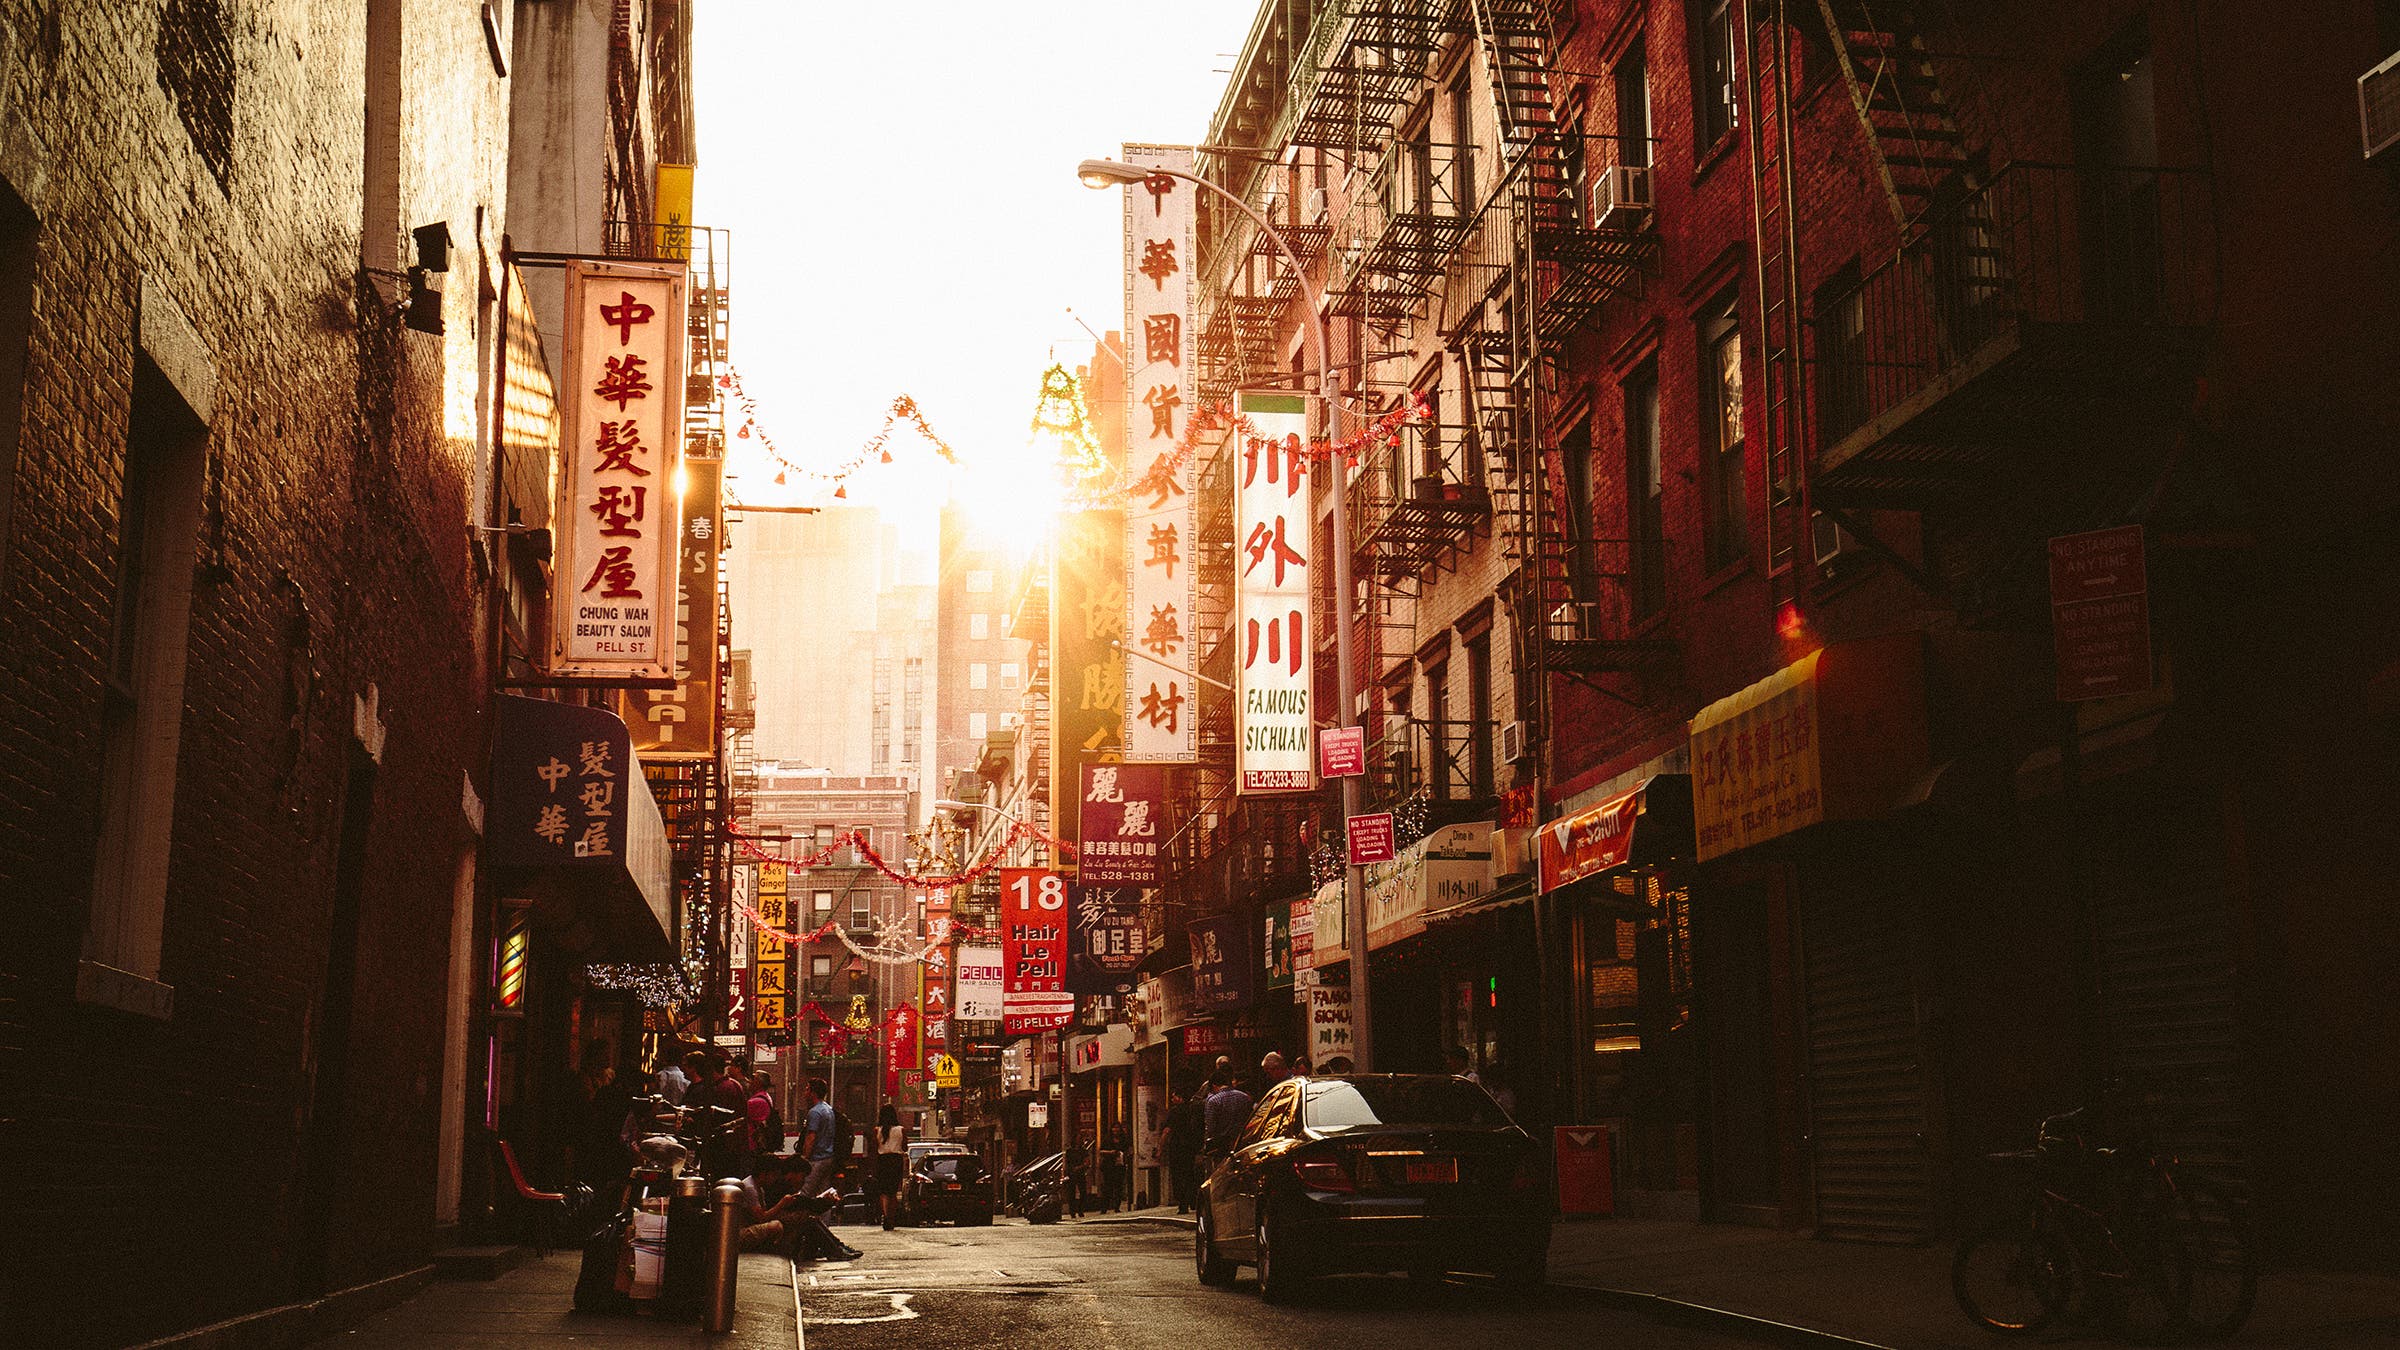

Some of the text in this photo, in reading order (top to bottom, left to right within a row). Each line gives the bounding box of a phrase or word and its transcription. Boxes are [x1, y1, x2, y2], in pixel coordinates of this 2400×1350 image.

[581, 291, 654, 600] 中華髮型屋
[1244, 432, 1307, 677] 川外川
[2054, 533, 2136, 557] NO STANDING
[2066, 553, 2128, 574] ANYTIME
[580, 606, 649, 620] CHUNG WAH
[576, 624, 651, 637] BEAUTY SALON
[596, 642, 646, 653] PELL ST.
[1247, 688, 1306, 715] FAMOUS
[1245, 726, 1307, 753] SICHUAN
[534, 754, 571, 845] 中華
[577, 740, 616, 857] 髮型屋
[1361, 818, 1389, 827] STANDING
[1453, 829, 1466, 841] Dine
[759, 877, 785, 889] Ginger
[1010, 875, 1063, 910] 18
[1438, 879, 1478, 900] 川外川
[1012, 924, 1060, 941] Hair
[1021, 943, 1050, 960] Le
[758, 898, 784, 1026] 錦江飯店
[1016, 961, 1058, 978] Pell
[960, 966, 1002, 980] PELL
[1024, 1017, 1053, 1028] PELL
[1054, 1015, 1070, 1026] ST
